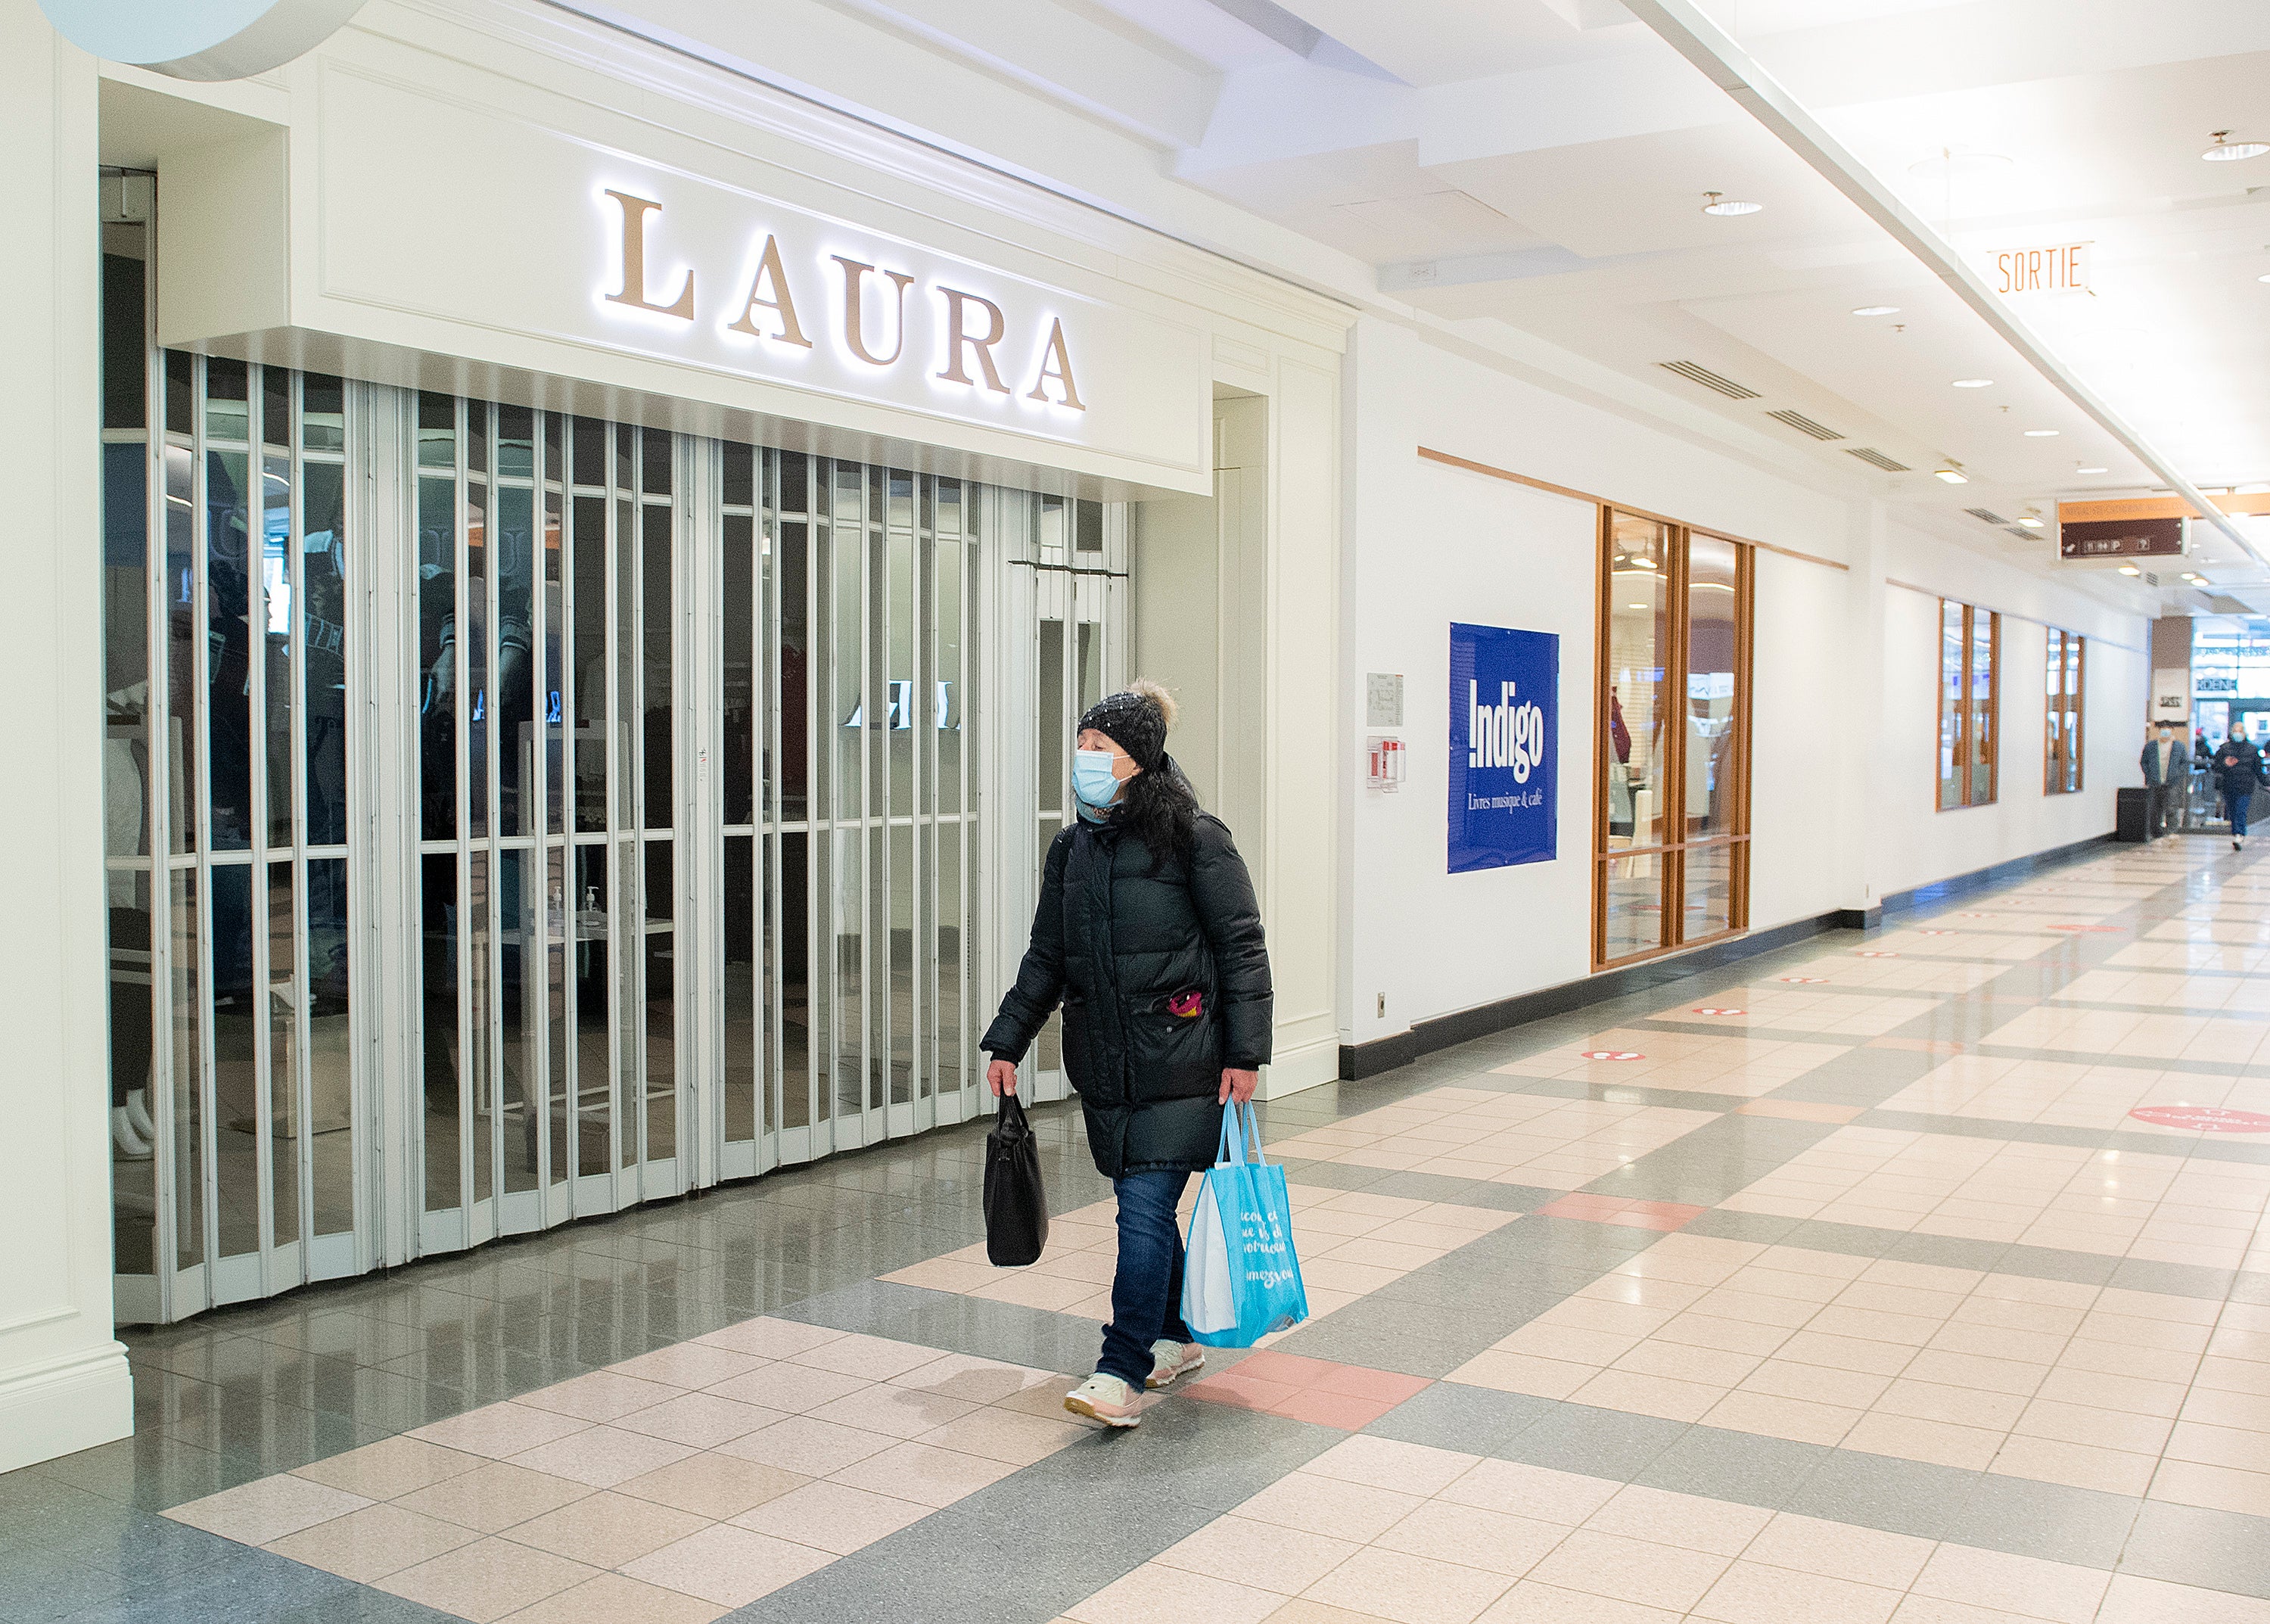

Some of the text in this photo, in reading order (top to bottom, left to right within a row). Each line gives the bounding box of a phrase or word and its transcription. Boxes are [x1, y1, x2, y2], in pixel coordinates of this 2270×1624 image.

[604, 188, 1087, 412] LAURA
[1998, 246, 2082, 293] SORTIE
[1469, 679, 1544, 784] Indigo
[1468, 787, 1543, 814] Livres musique & café
